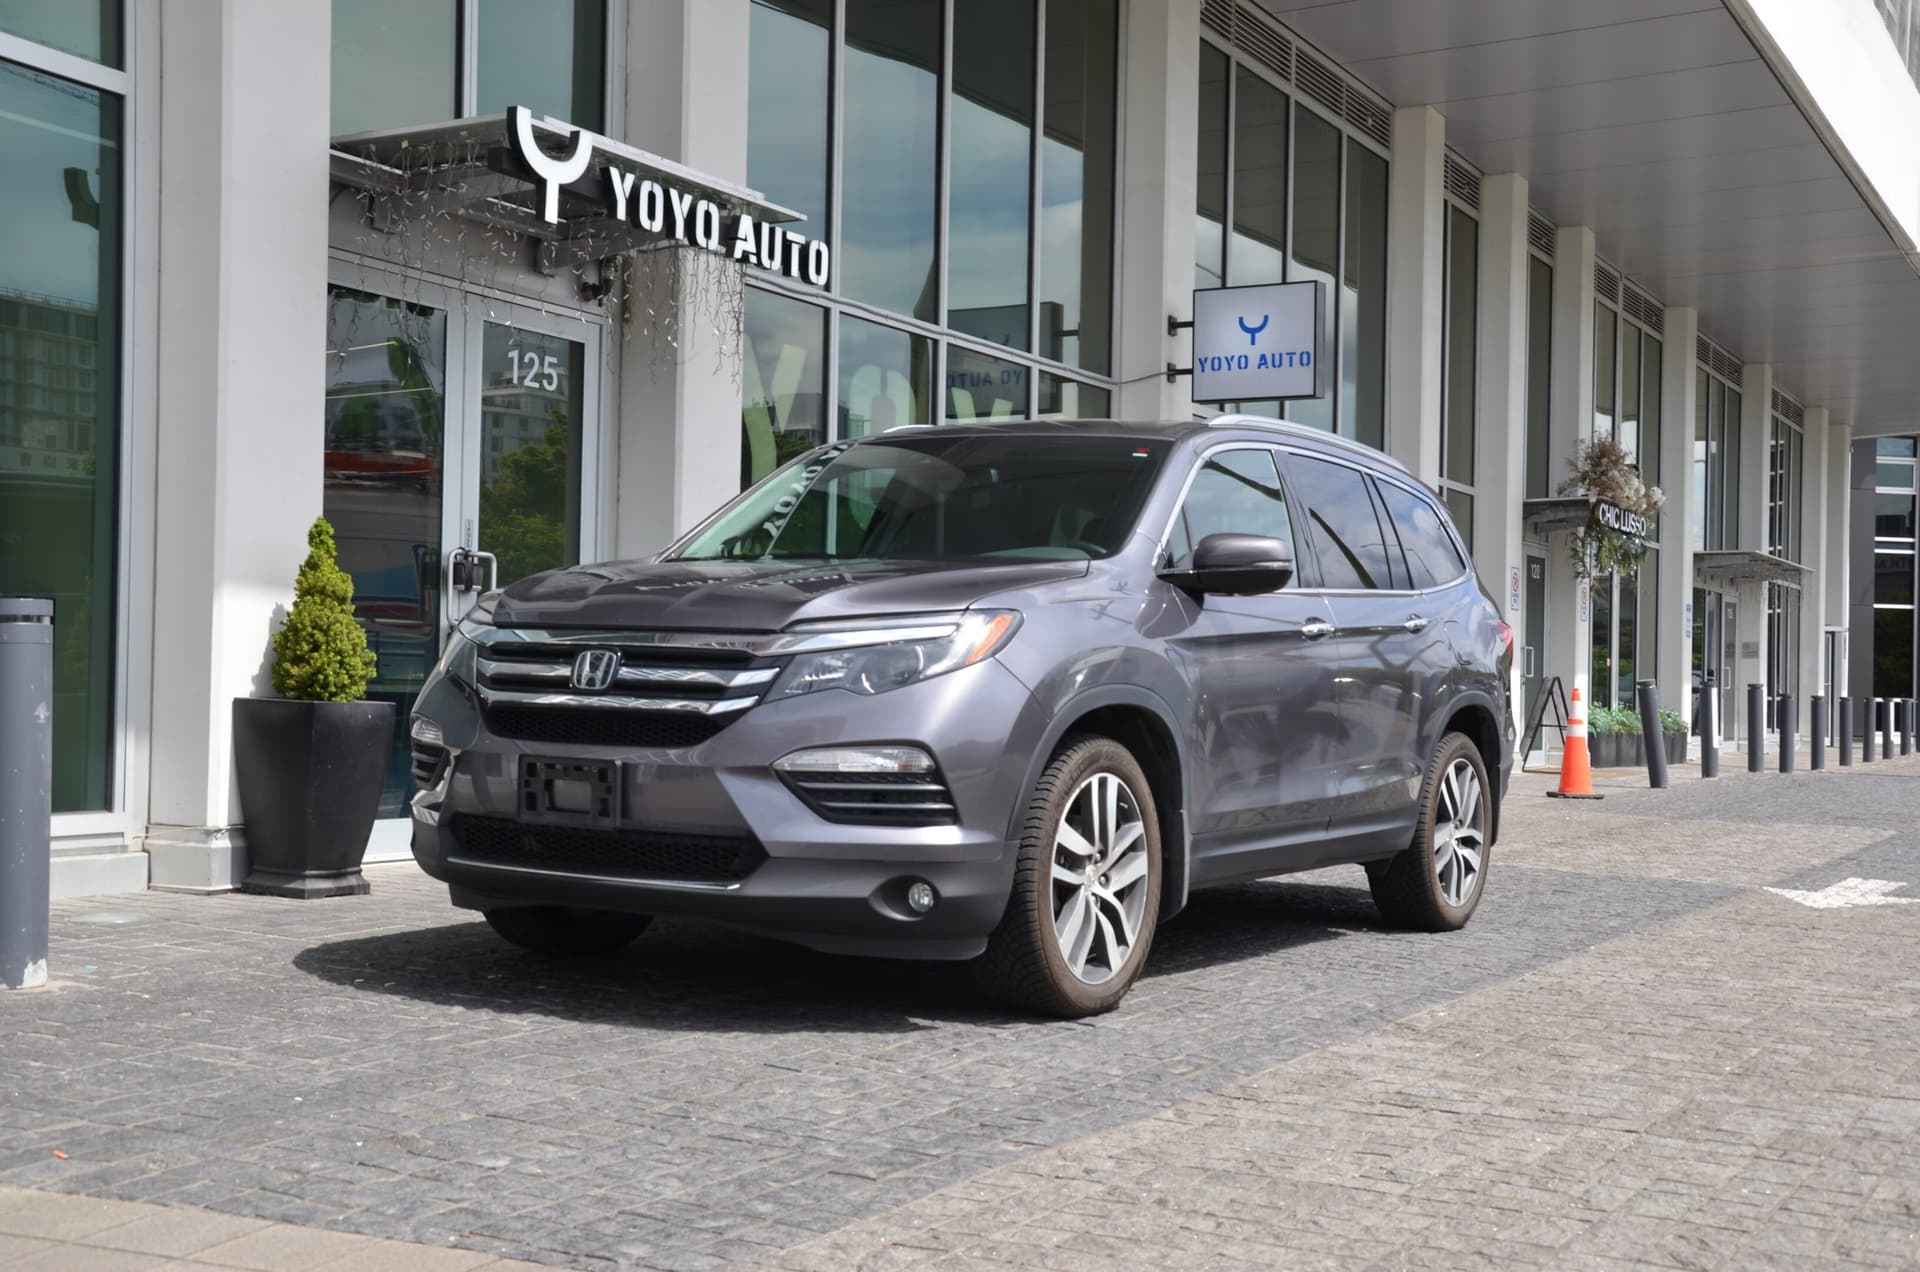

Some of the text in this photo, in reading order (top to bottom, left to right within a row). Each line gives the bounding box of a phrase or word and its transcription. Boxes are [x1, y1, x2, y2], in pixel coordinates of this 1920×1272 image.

[609, 166, 829, 286] YOYO AUTO
[507, 349, 558, 392] 125
[1197, 351, 1312, 373] YOYO AUTO
[1599, 503, 1646, 537] CHIC LUSSO
